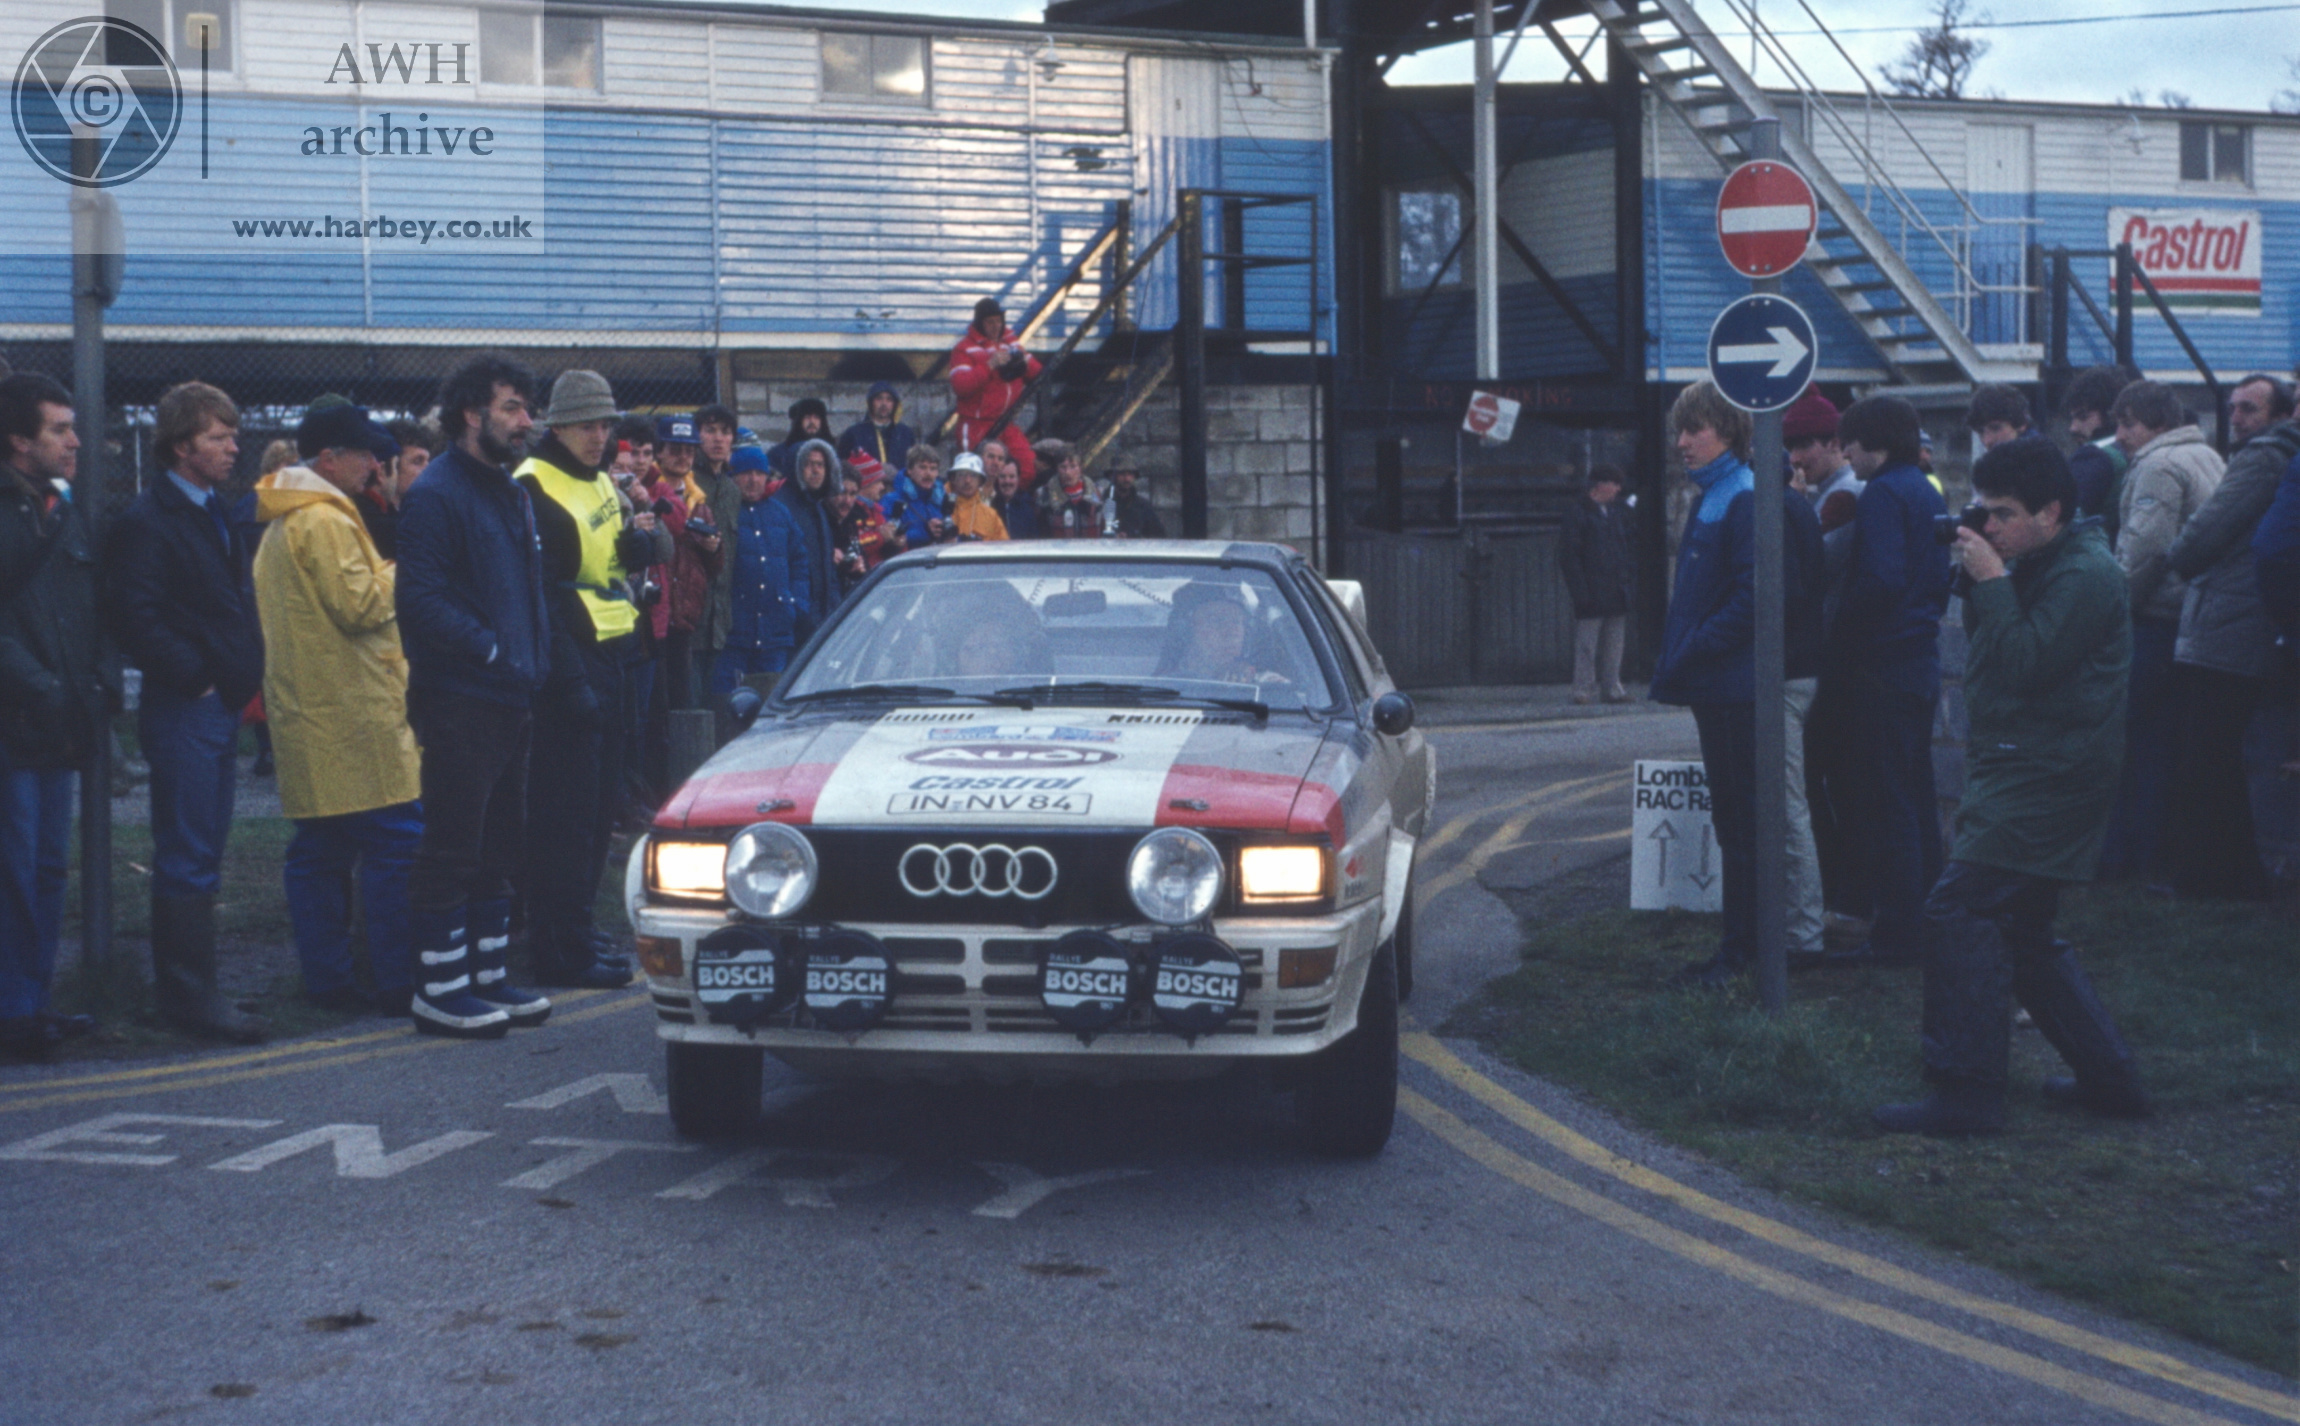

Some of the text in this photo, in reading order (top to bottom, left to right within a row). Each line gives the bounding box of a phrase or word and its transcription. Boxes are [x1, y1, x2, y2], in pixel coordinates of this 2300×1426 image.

[2122, 216, 2249, 271] Castrol
[909, 776, 1083, 790] Castrol
[1636, 789, 1684, 810] RAC
[698, 965, 775, 986] BOSCH
[807, 971, 886, 992] BOSCH
[1045, 969, 1126, 994] BOSCH
[1156, 971, 1239, 998] BOSCH
